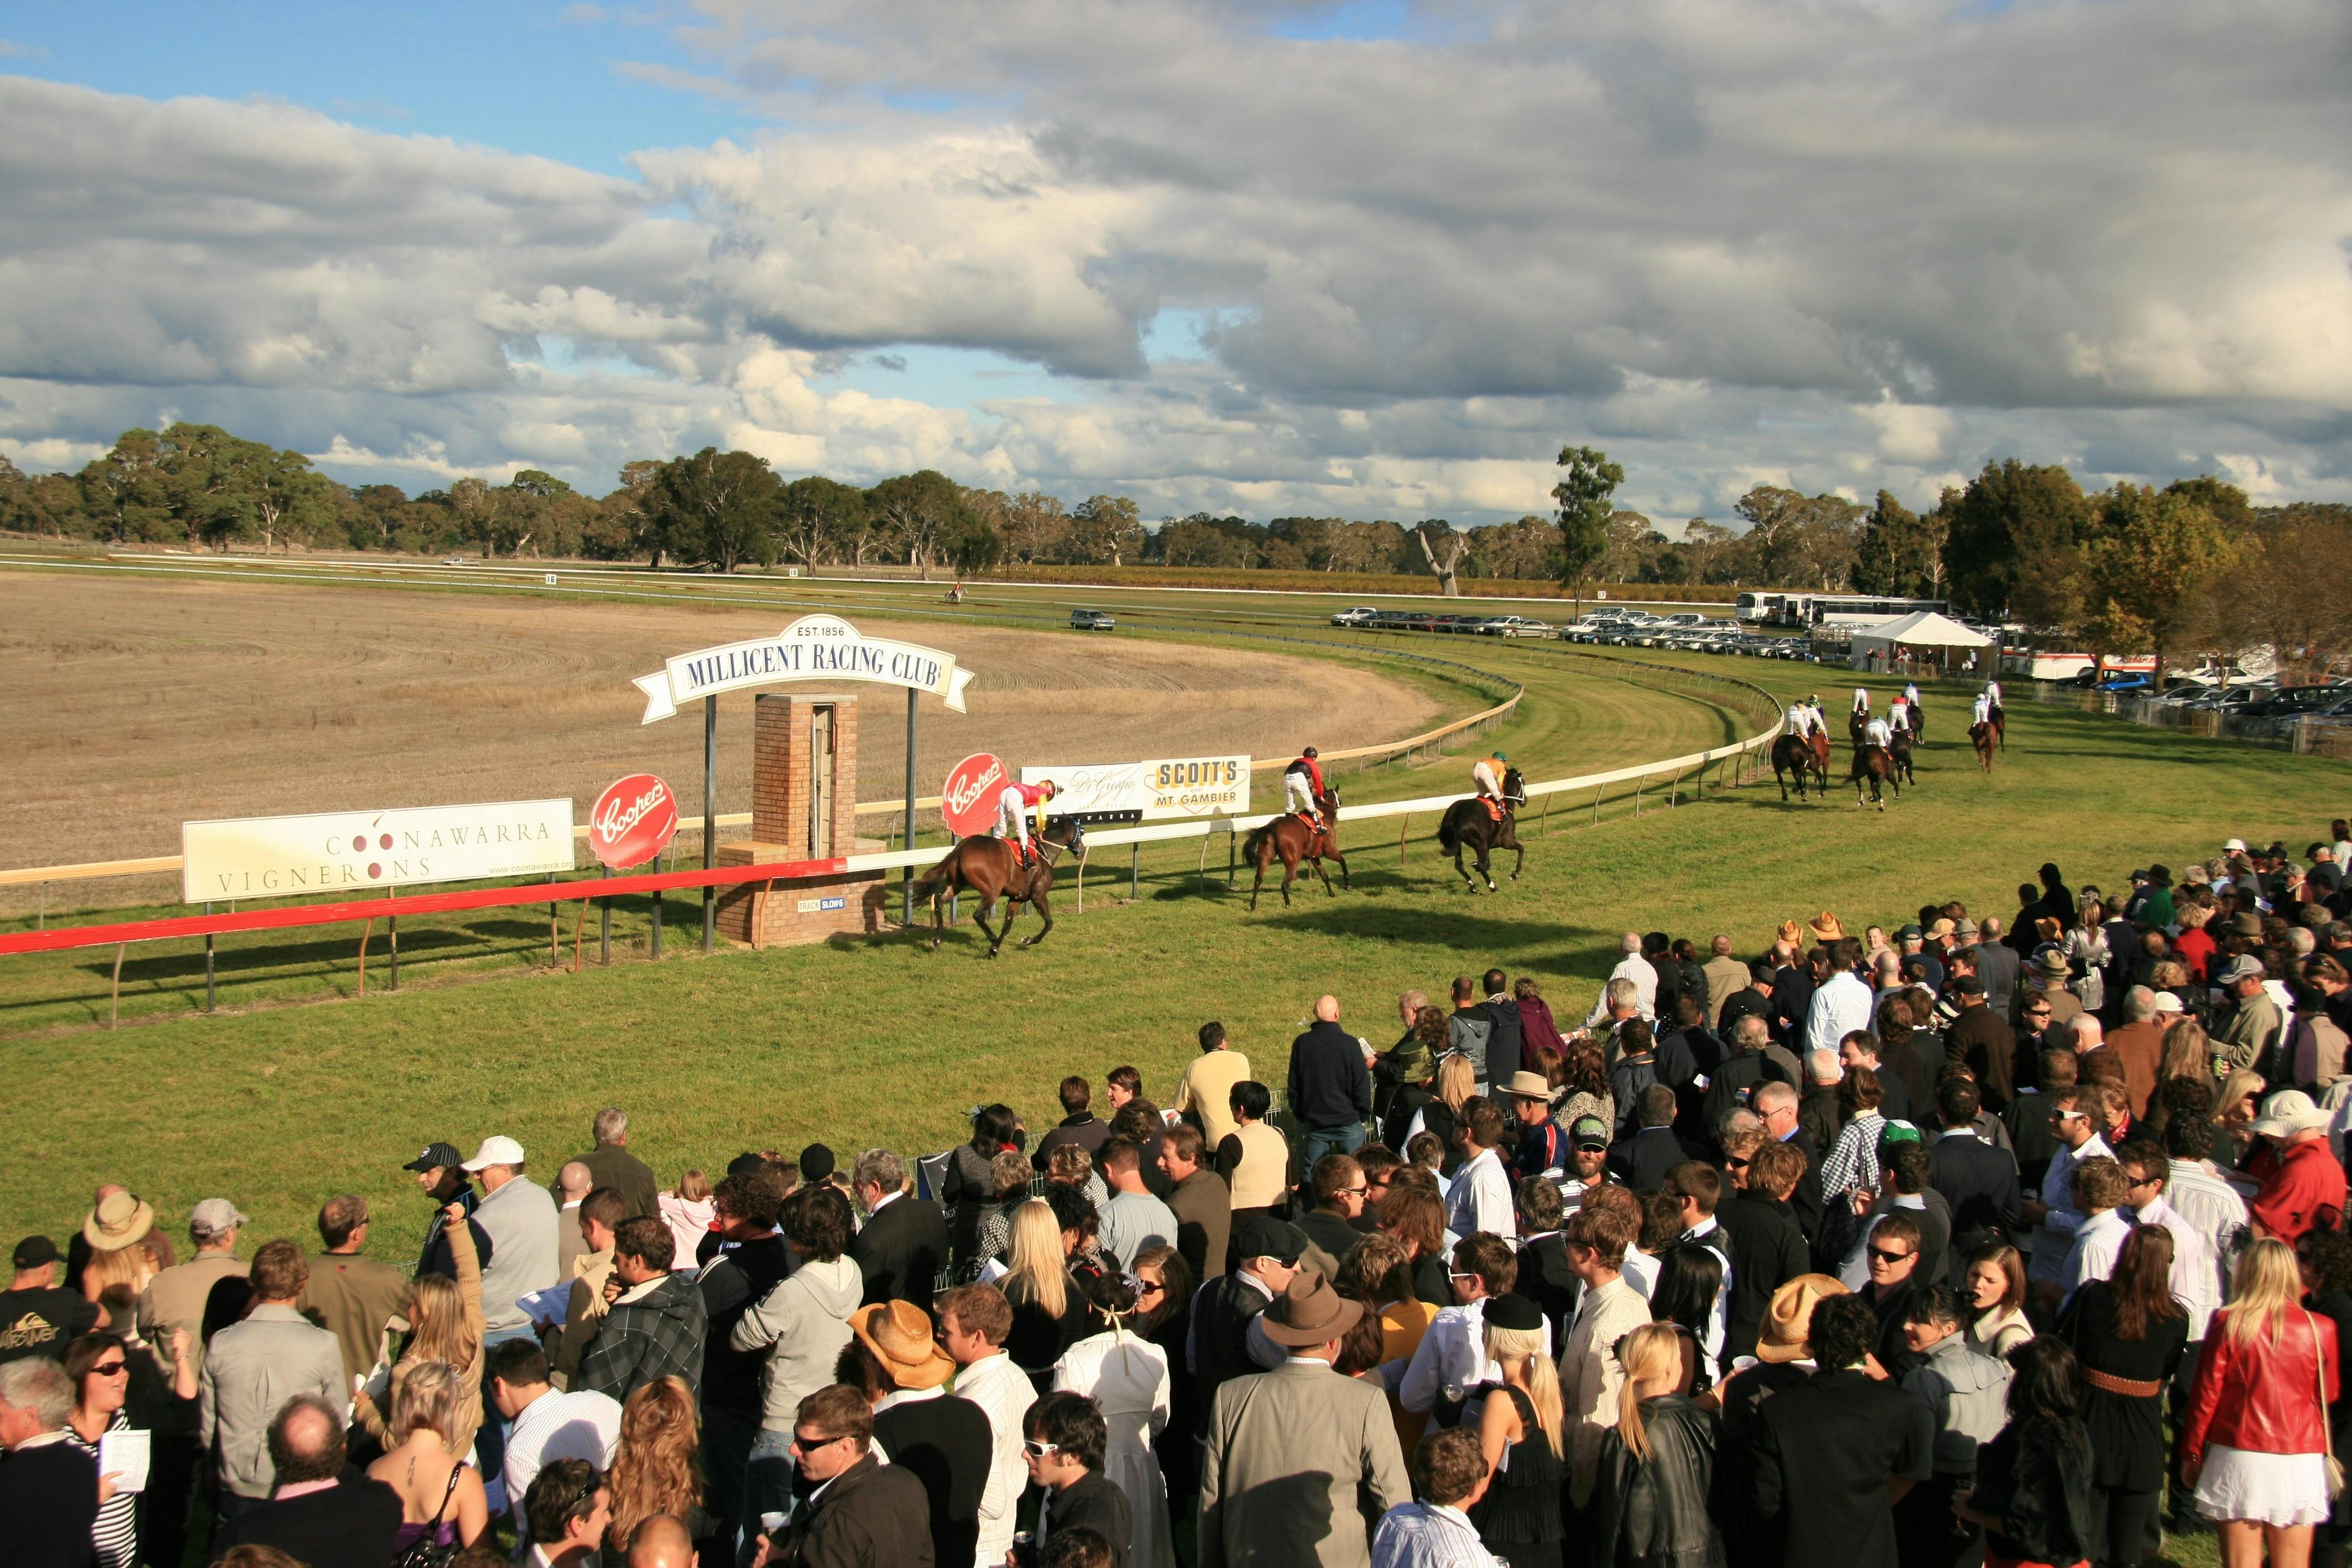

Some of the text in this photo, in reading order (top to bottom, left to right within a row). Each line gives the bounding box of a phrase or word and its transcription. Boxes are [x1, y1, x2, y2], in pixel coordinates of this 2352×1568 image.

[687, 644, 939, 690] MILLICENT RACING CLUB
[1159, 760, 1237, 786] SCOTT'S
[1181, 792, 1236, 805] GAMBIER
[488, 861, 575, 874] www.coonawarra.org
